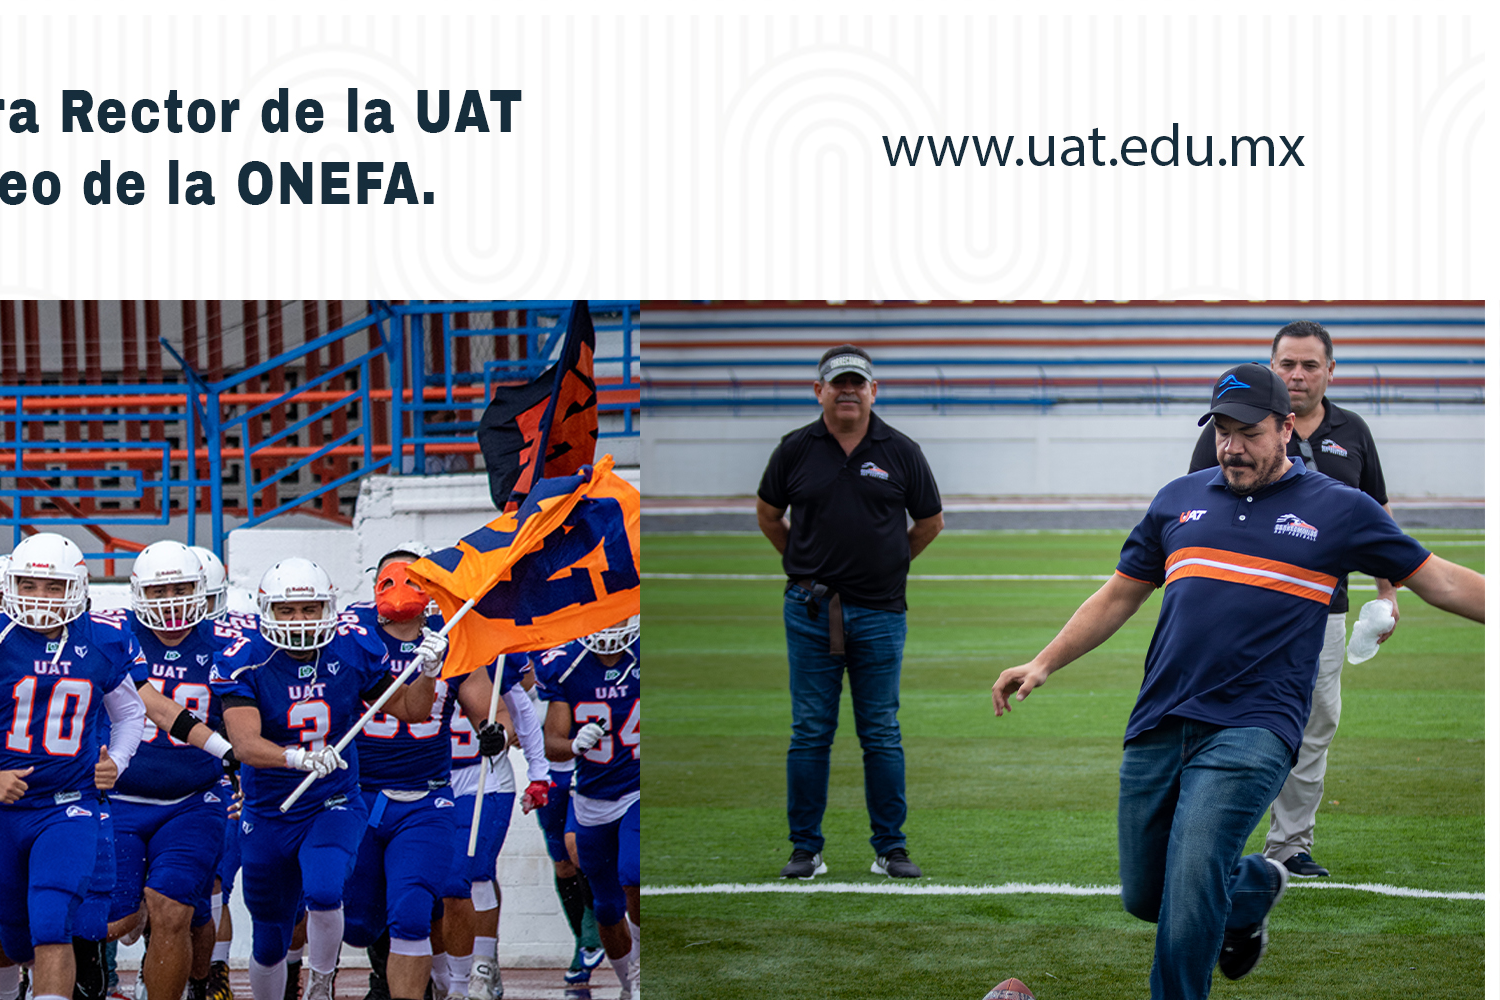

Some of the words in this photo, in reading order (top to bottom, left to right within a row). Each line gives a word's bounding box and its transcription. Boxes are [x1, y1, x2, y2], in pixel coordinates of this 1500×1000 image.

[1179, 509, 1207, 523] UAT
[33, 660, 72, 675] UAT
[151, 663, 188, 679] UAT
[287, 682, 327, 700] UAT
[595, 685, 629, 699] UAT
[5, 675, 94, 757] 10
[286, 700, 332, 752] 3
